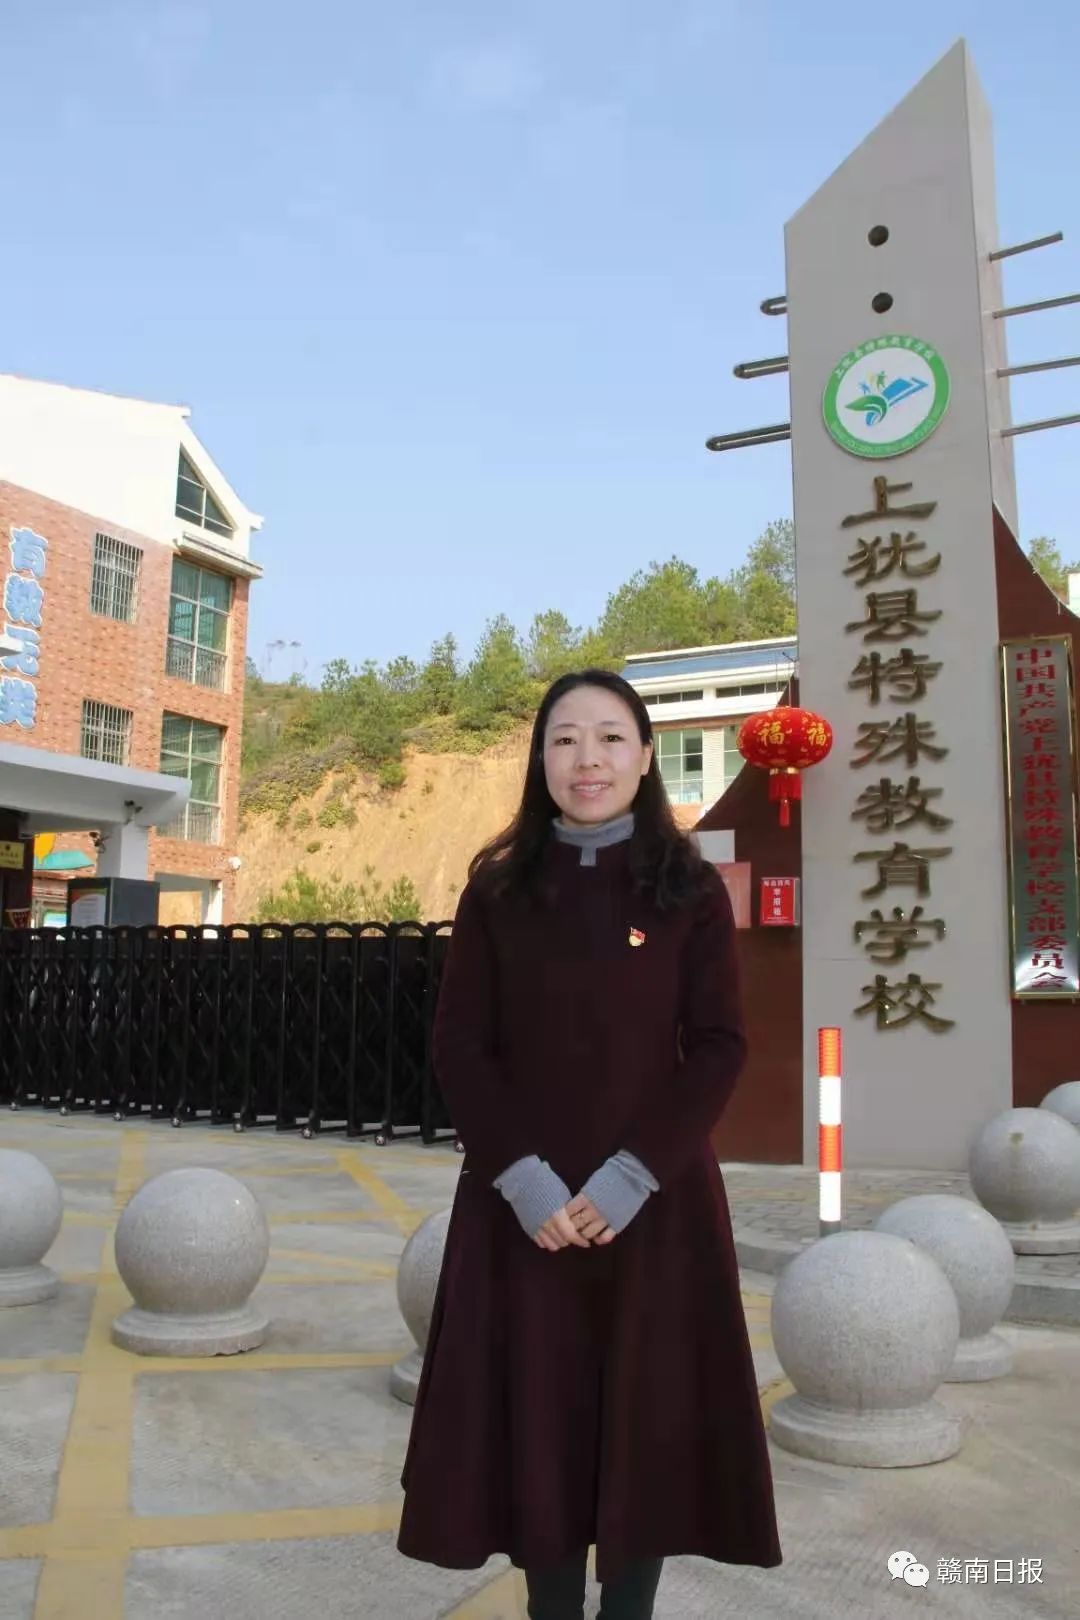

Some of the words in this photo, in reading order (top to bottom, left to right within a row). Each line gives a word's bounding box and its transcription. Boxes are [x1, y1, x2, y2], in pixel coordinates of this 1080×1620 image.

[758, 721, 785, 746] 福
[807, 722, 826, 746] 福
[841, 475, 956, 1034] 上犹县特殊教育学校
